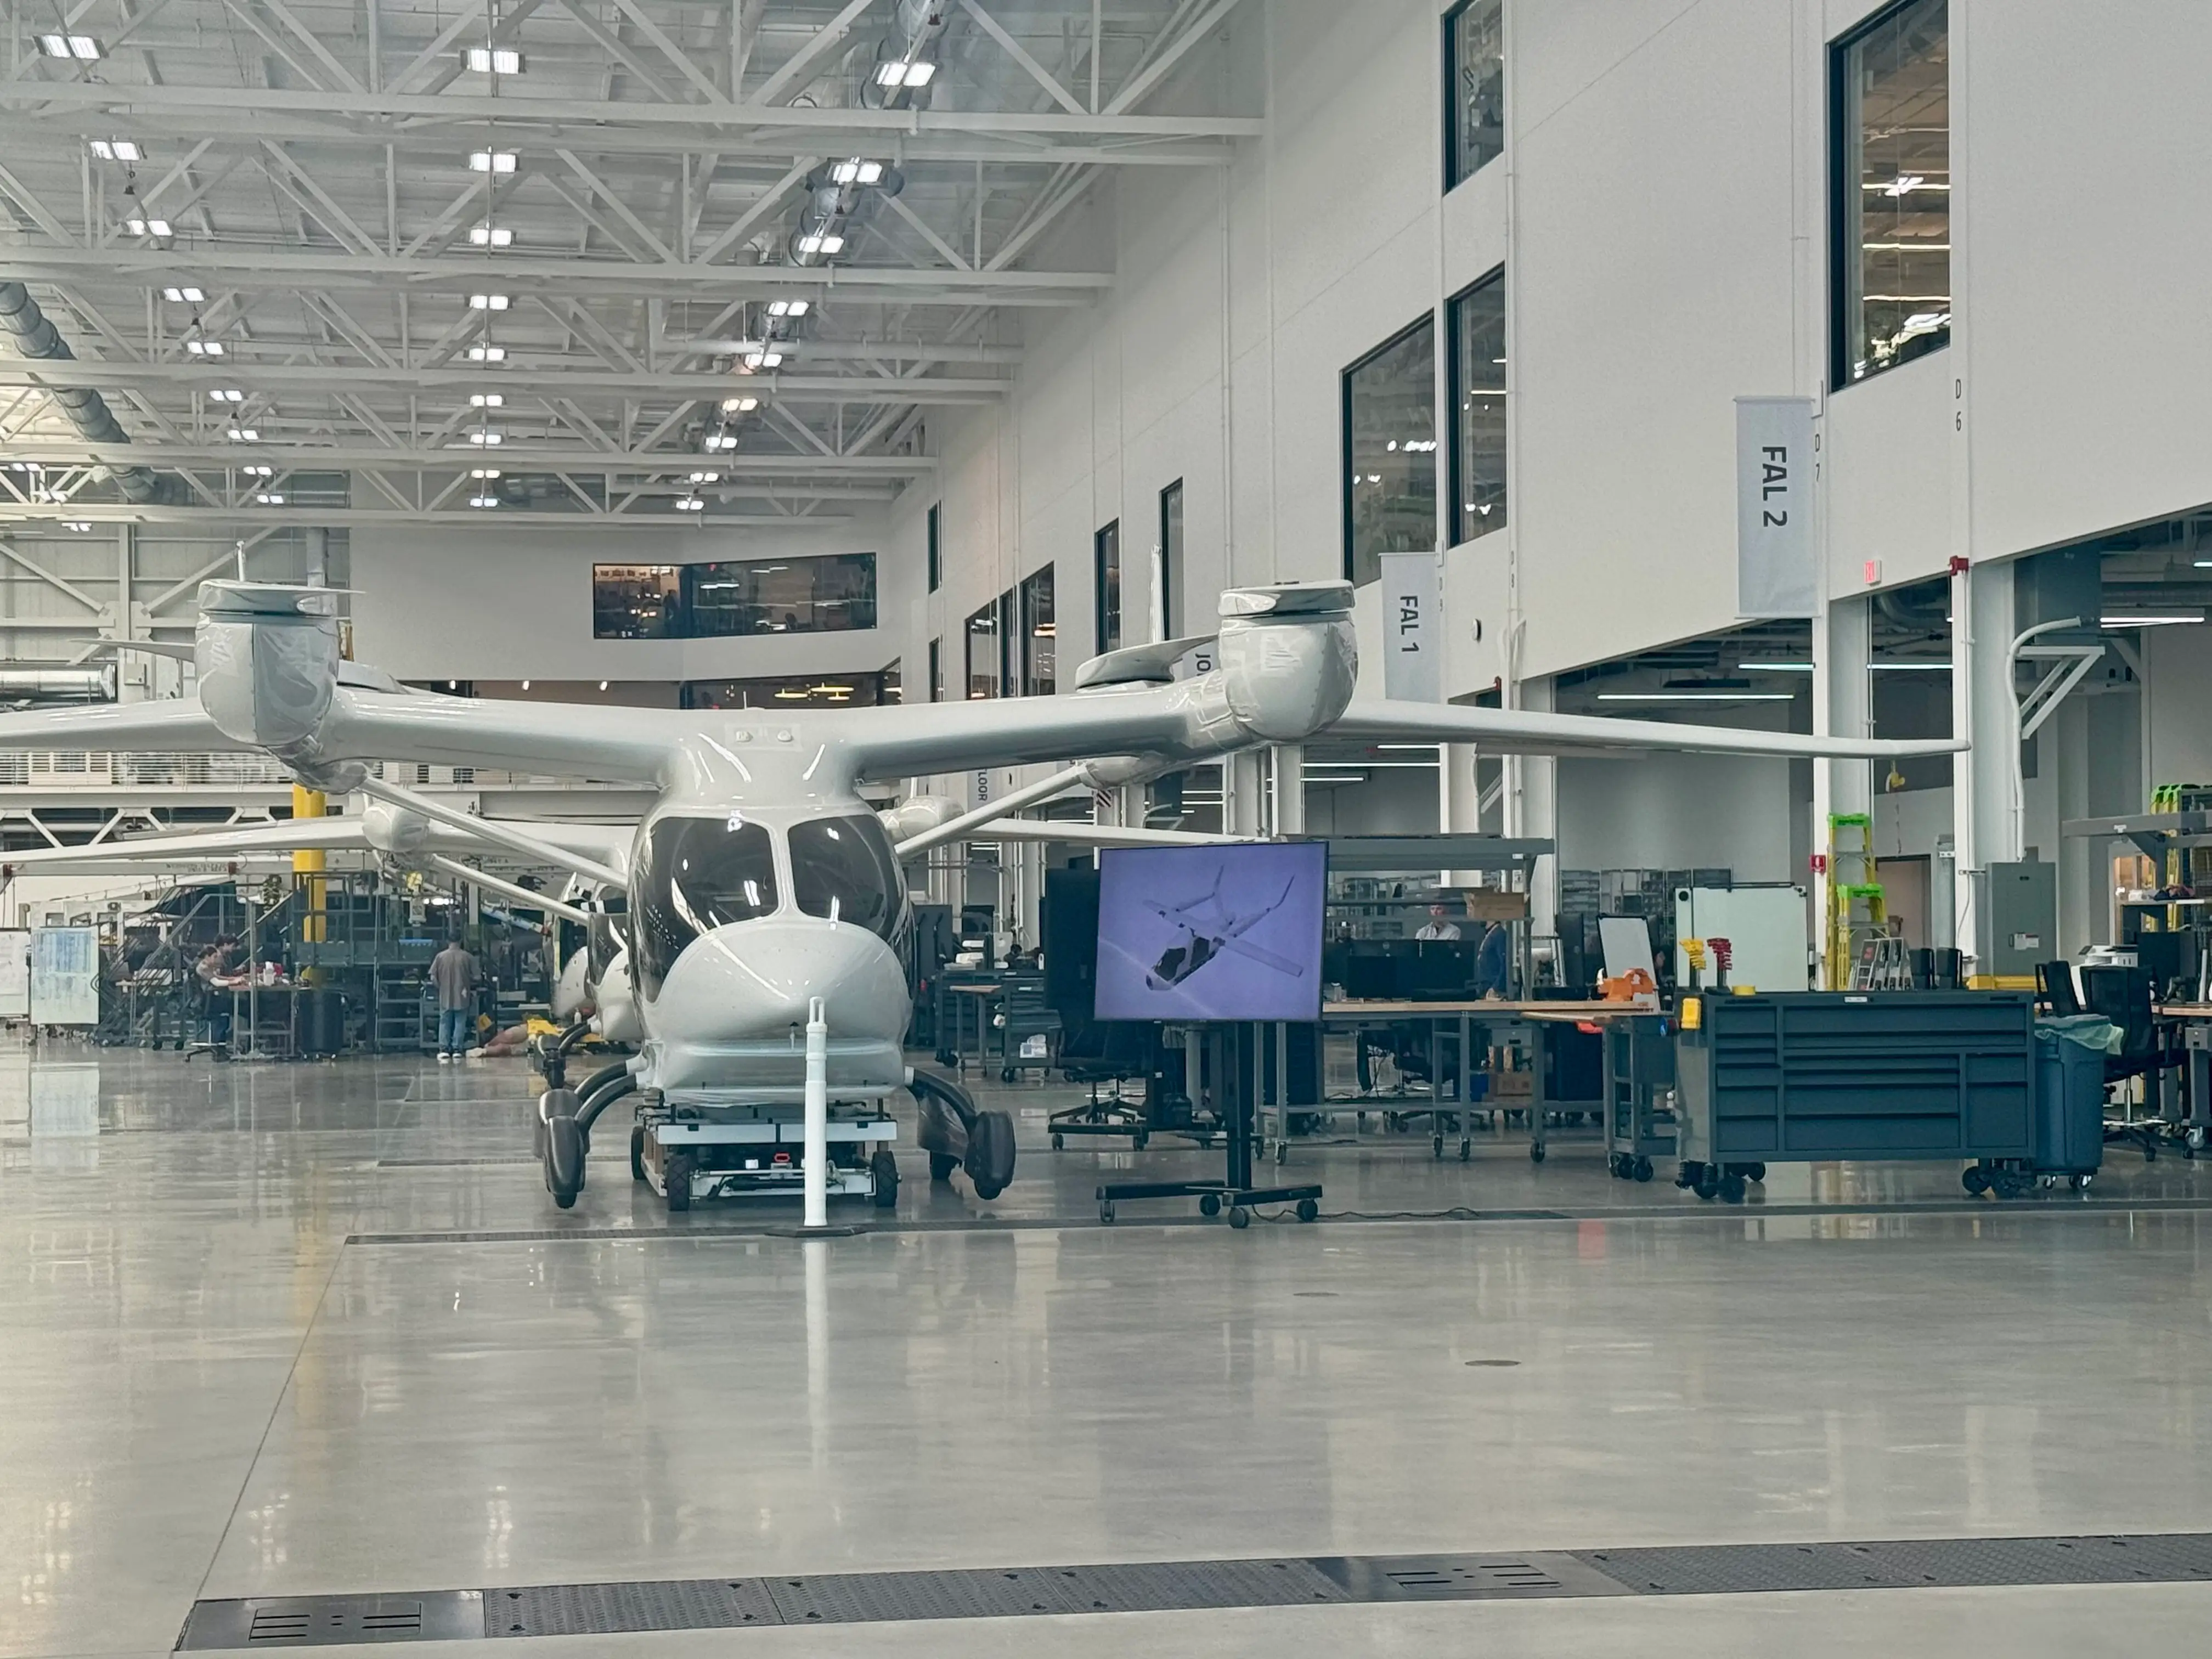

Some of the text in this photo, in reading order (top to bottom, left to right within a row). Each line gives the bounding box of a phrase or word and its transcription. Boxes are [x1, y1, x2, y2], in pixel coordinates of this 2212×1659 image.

[1762, 446, 1787, 527] FAL 2
[1400, 596, 1419, 652] FAL 1
[1195, 653, 1211, 676] JO
[978, 769, 988, 800] LOOR
